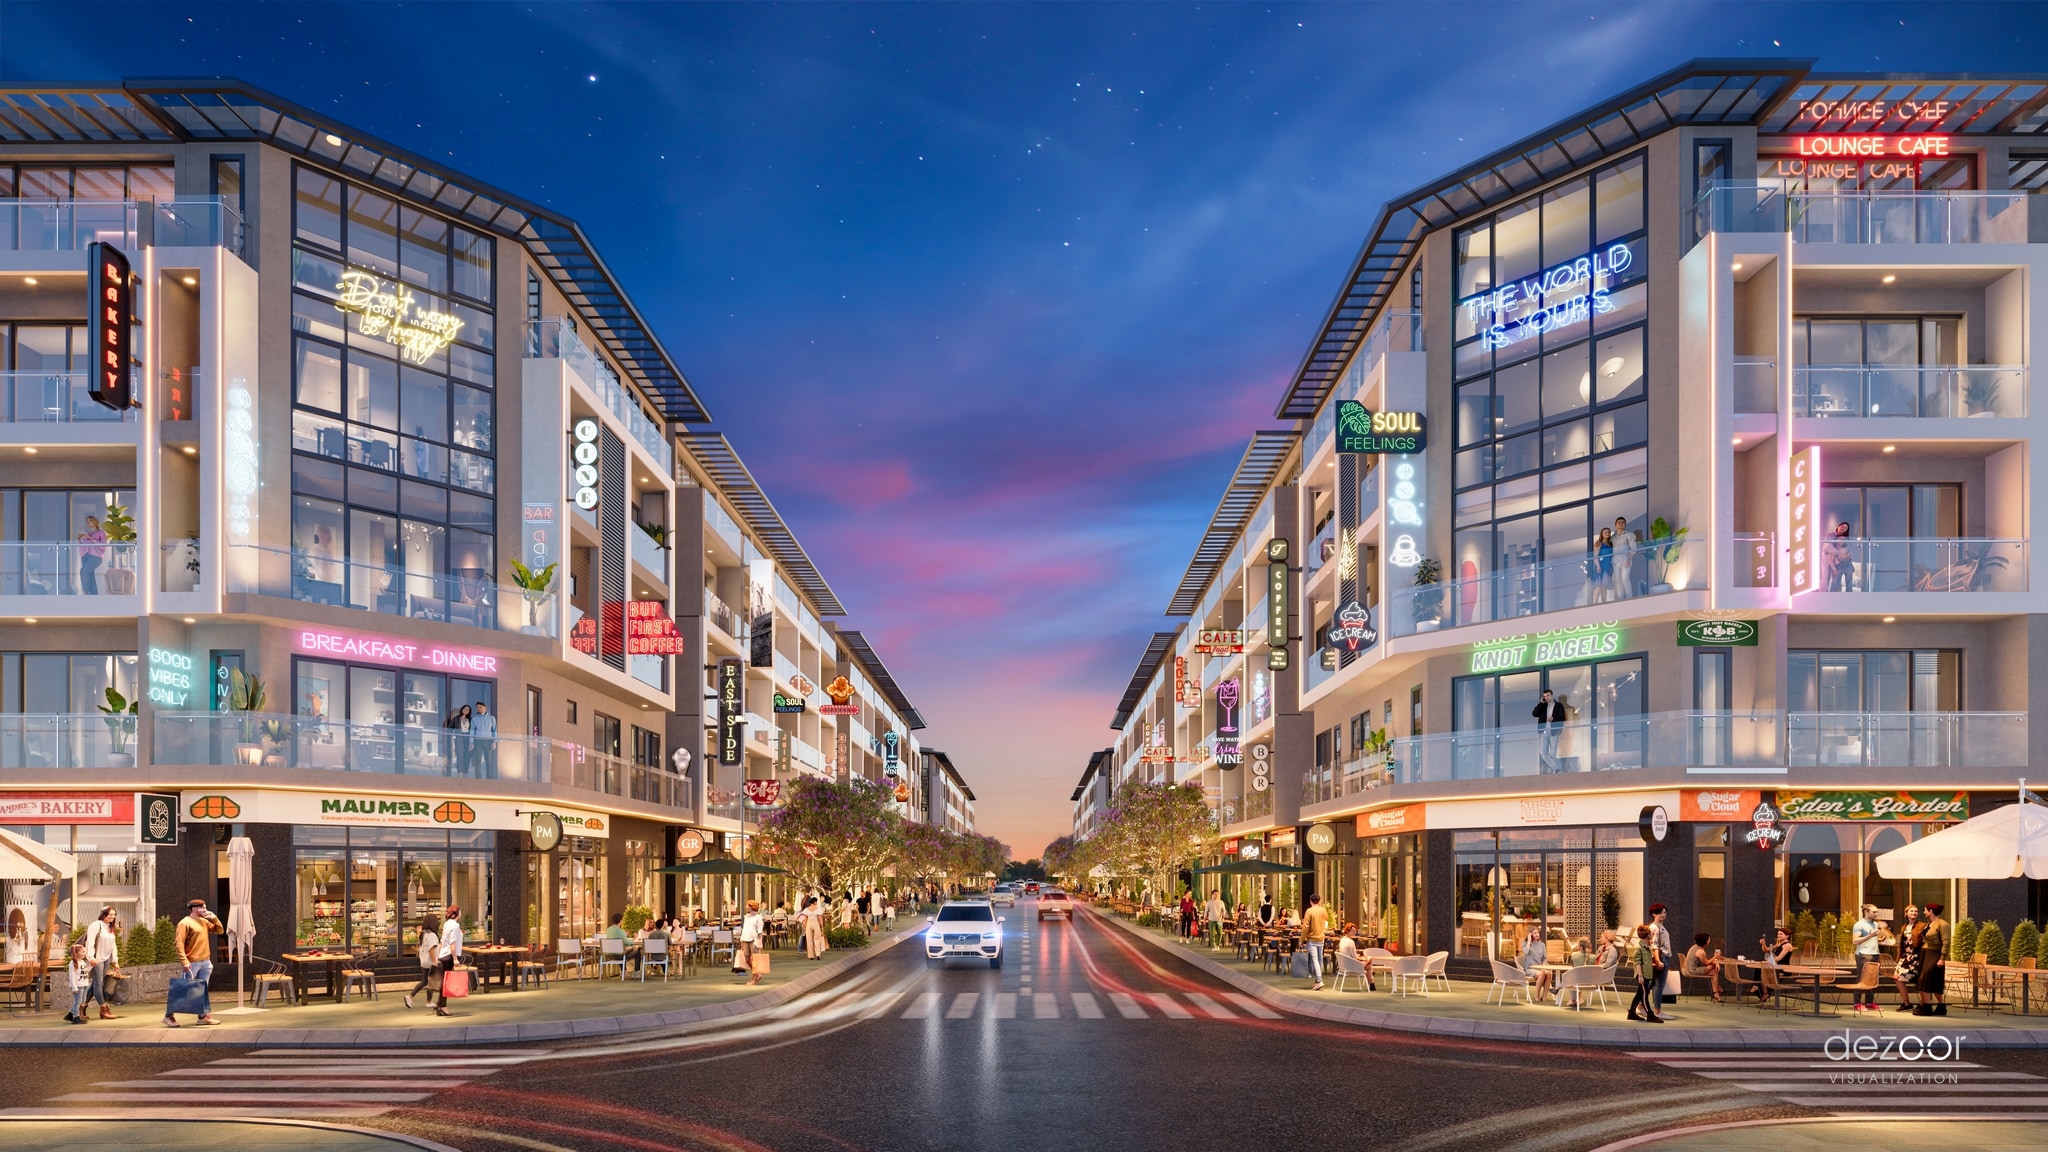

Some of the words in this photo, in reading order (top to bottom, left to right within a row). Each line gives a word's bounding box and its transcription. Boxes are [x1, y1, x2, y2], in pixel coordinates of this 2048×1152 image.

[1800, 137, 1885, 155] LOUNGE
[1898, 137, 1949, 155] CAFE
[1463, 284, 1517, 322] THE
[1523, 244, 1630, 298] WORLD
[106, 263, 119, 389] BAKERY
[1482, 323, 1508, 350] IS
[1514, 287, 1612, 338] YOURS
[1372, 411, 1422, 433] SOUL
[1344, 436, 1416, 450] FEELINGS
[524, 507, 553, 520] BAR
[1794, 459, 1806, 587] COFFEE
[629, 601, 658, 618] BUT
[1274, 570, 1283, 638] COFFEE
[629, 619, 677, 637] FIRST,
[629, 637, 684, 653] COFFEE
[1202, 632, 1238, 643] CAFE
[302, 631, 417, 662] BREAKFAST
[1472, 644, 1527, 673] KNOT
[1535, 631, 1619, 664] BAGELS
[149, 648, 191, 670] GOOD
[149, 667, 190, 689] VIBES
[149, 687, 188, 706] ONLY
[725, 665, 736, 711] EAST
[785, 698, 804, 707] SOUL
[726, 715, 737, 761] SIDE
[1145, 748, 1170, 756] CAFE
[1214, 754, 1244, 764] WINE
[884, 767, 898, 775] WIN
[749, 781, 779, 798] Coffee
[1711, 792, 1740, 803] Sugar
[41, 801, 105, 814] BAKERY
[1380, 809, 1406, 820] Sugar
[1711, 802, 1740, 812] Cloud
[1781, 797, 1864, 815] Eden's
[1870, 796, 1964, 817] Garden
[1380, 817, 1405, 827] Cloud
[535, 825, 553, 838] PM
[1311, 833, 1329, 844] PM
[681, 838, 700, 849] GR
